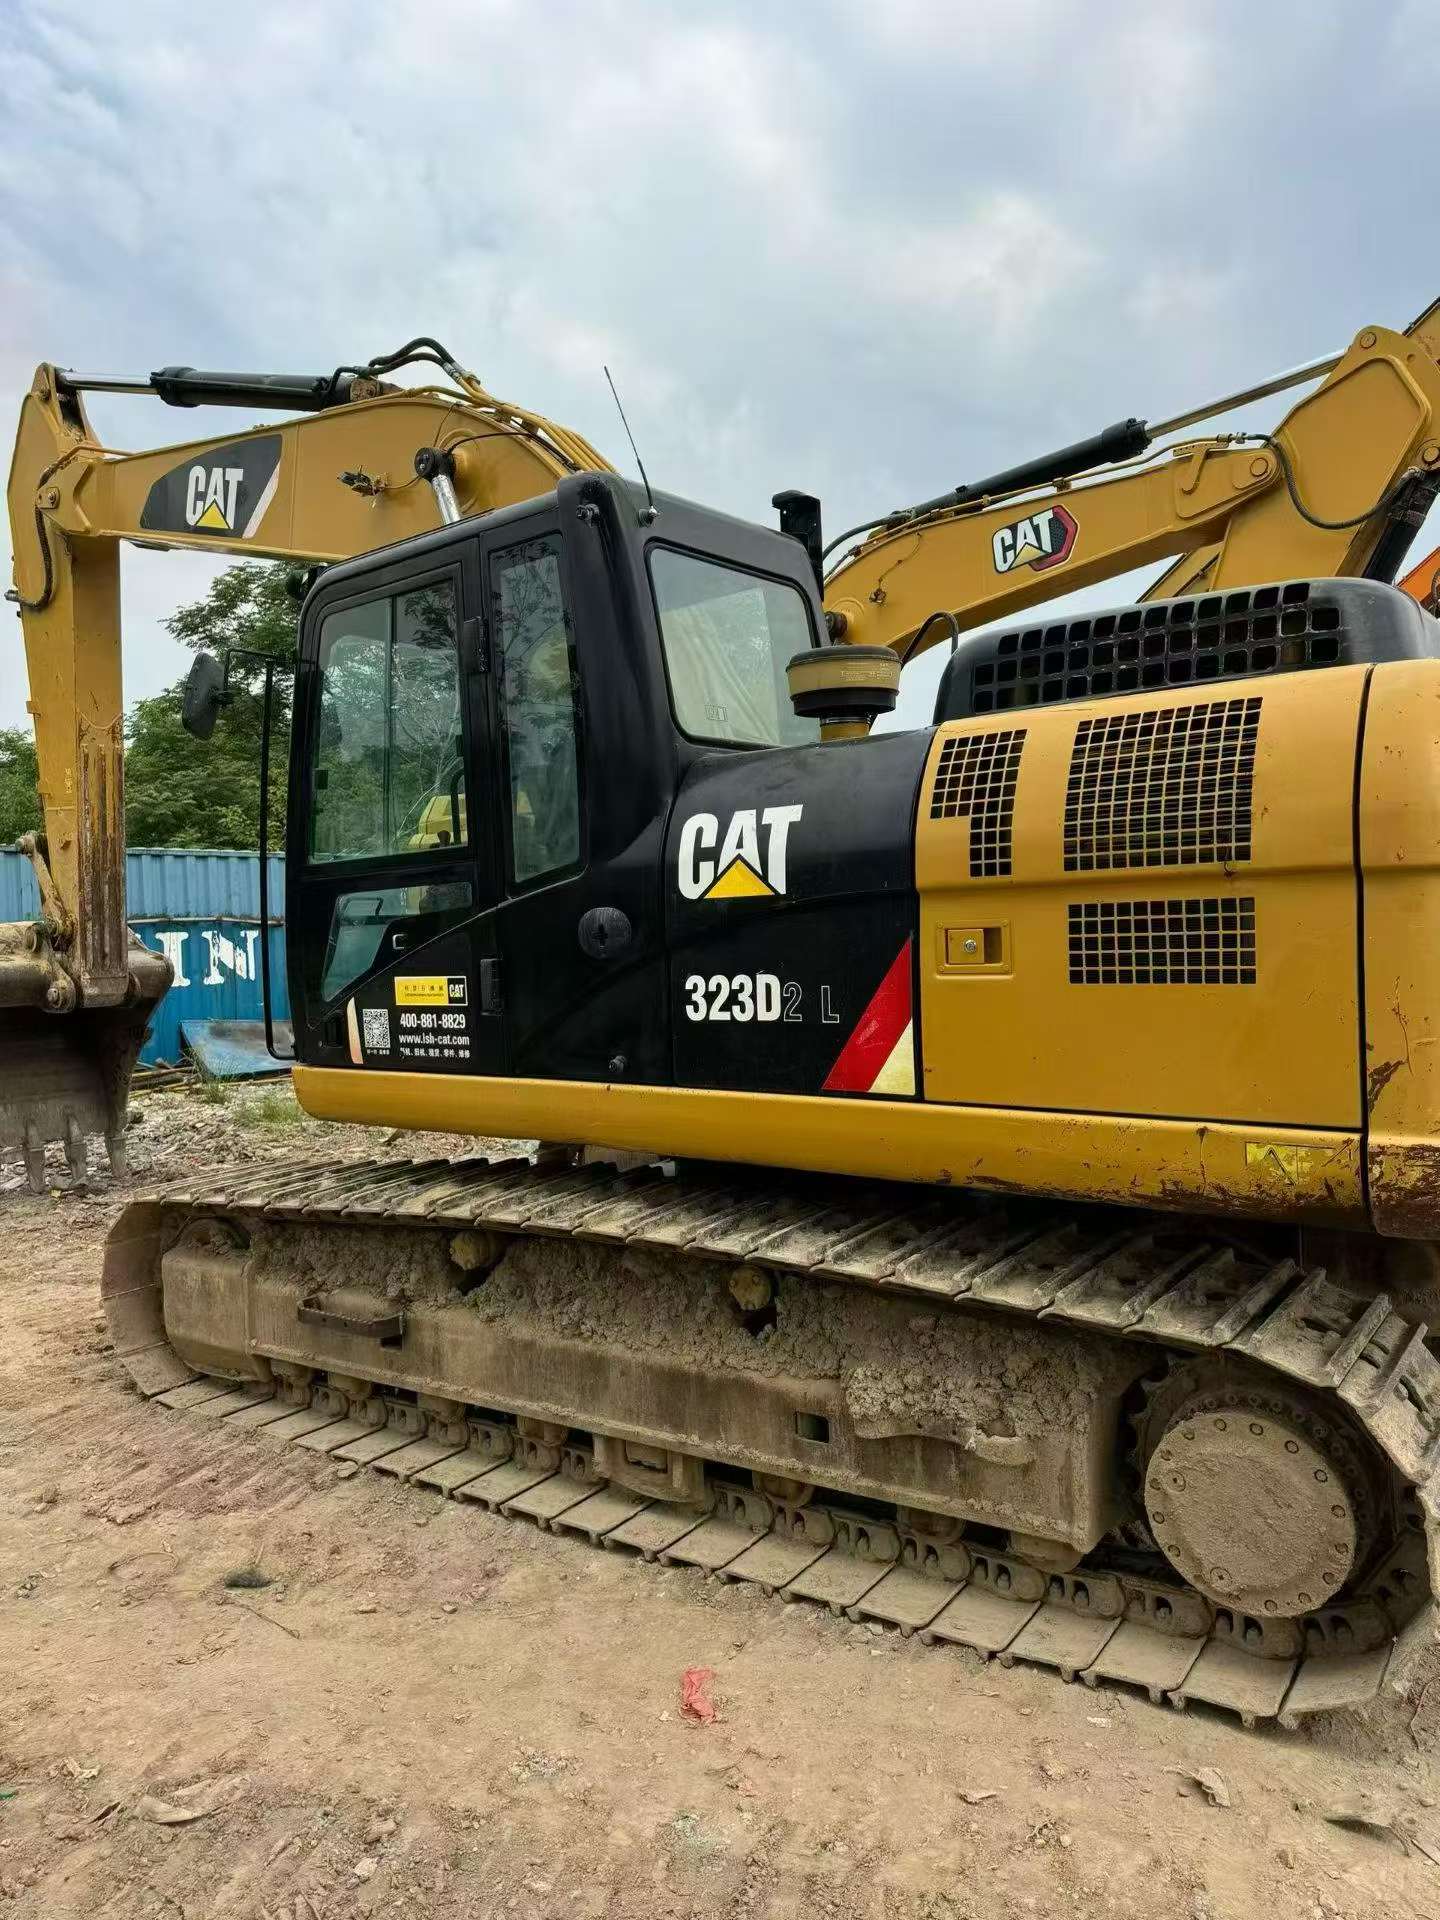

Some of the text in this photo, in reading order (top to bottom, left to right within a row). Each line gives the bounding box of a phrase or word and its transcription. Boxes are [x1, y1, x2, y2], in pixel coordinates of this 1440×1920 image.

[185, 465, 244, 530] CAT
[993, 509, 1054, 573] CAT
[678, 804, 804, 900] CAT
[449, 984, 464, 998] CAT
[821, 985, 840, 1024] L
[399, 1033, 470, 1045] www.lsh-cat.com
[400, 1013, 466, 1029] 400-881-8829
